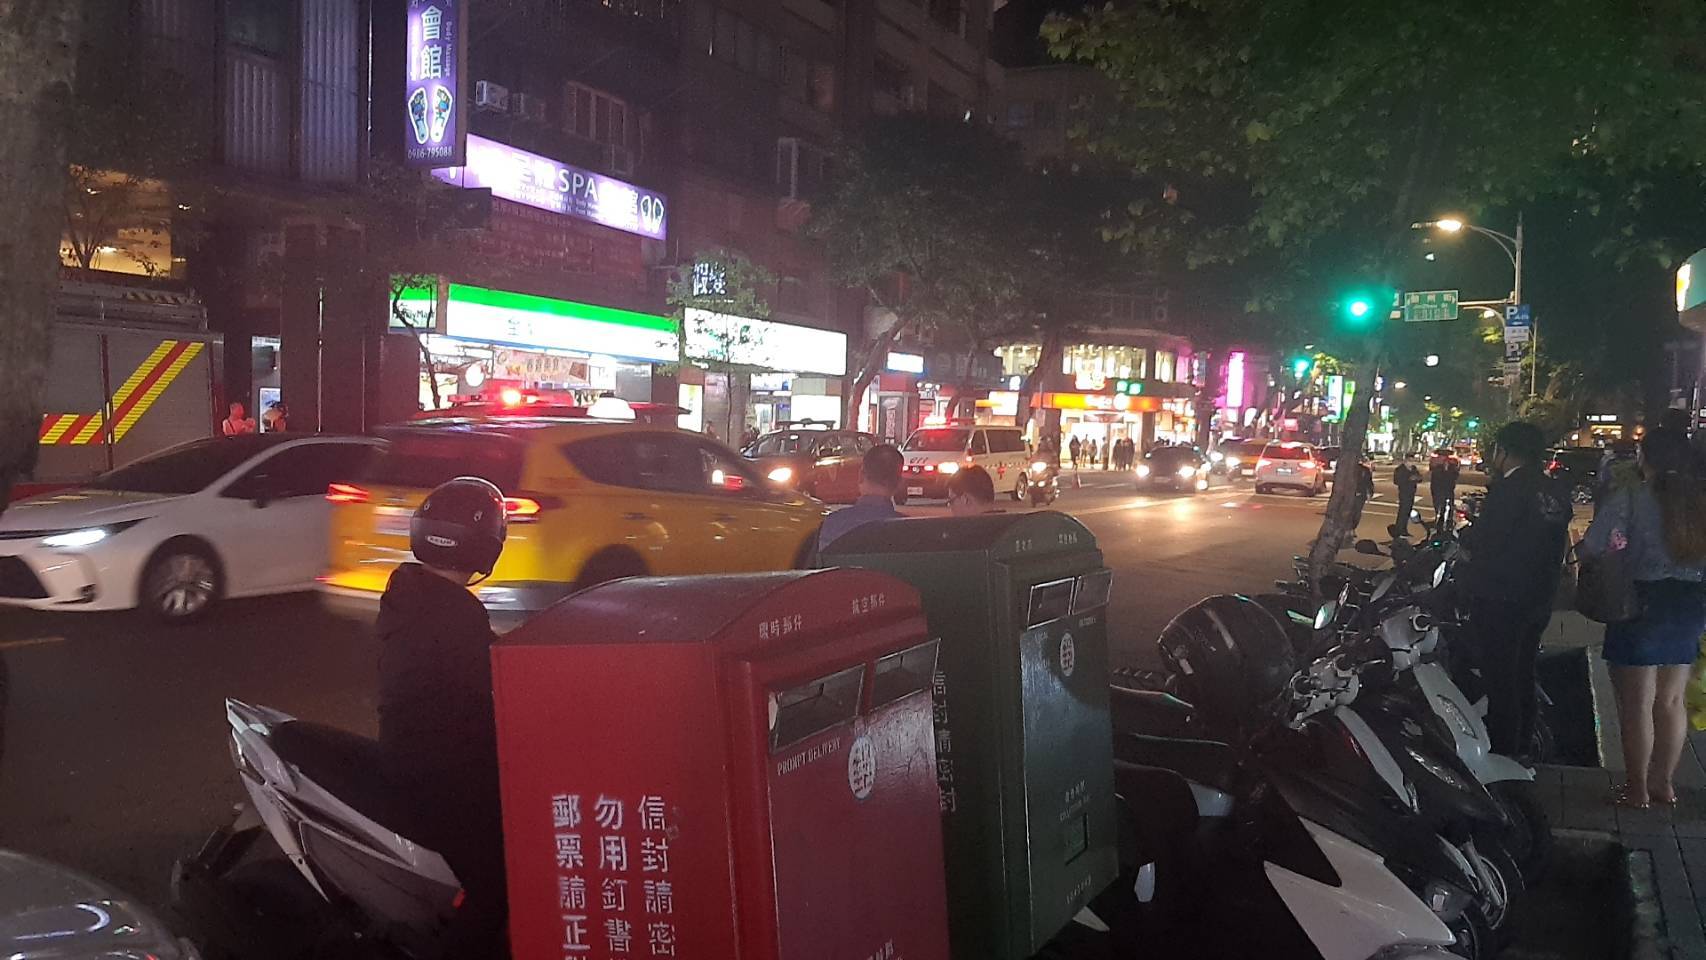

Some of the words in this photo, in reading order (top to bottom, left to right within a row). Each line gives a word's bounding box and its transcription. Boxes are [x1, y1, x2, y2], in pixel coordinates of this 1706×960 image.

[420, 4, 443, 80] 會館
[559, 168, 600, 201] SPA
[777, 751, 807, 777] PROMPT
[808, 736, 841, 763] DELIVERY
[551, 794, 591, 960] 郵票請正
[593, 793, 633, 960] 勿用釘書
